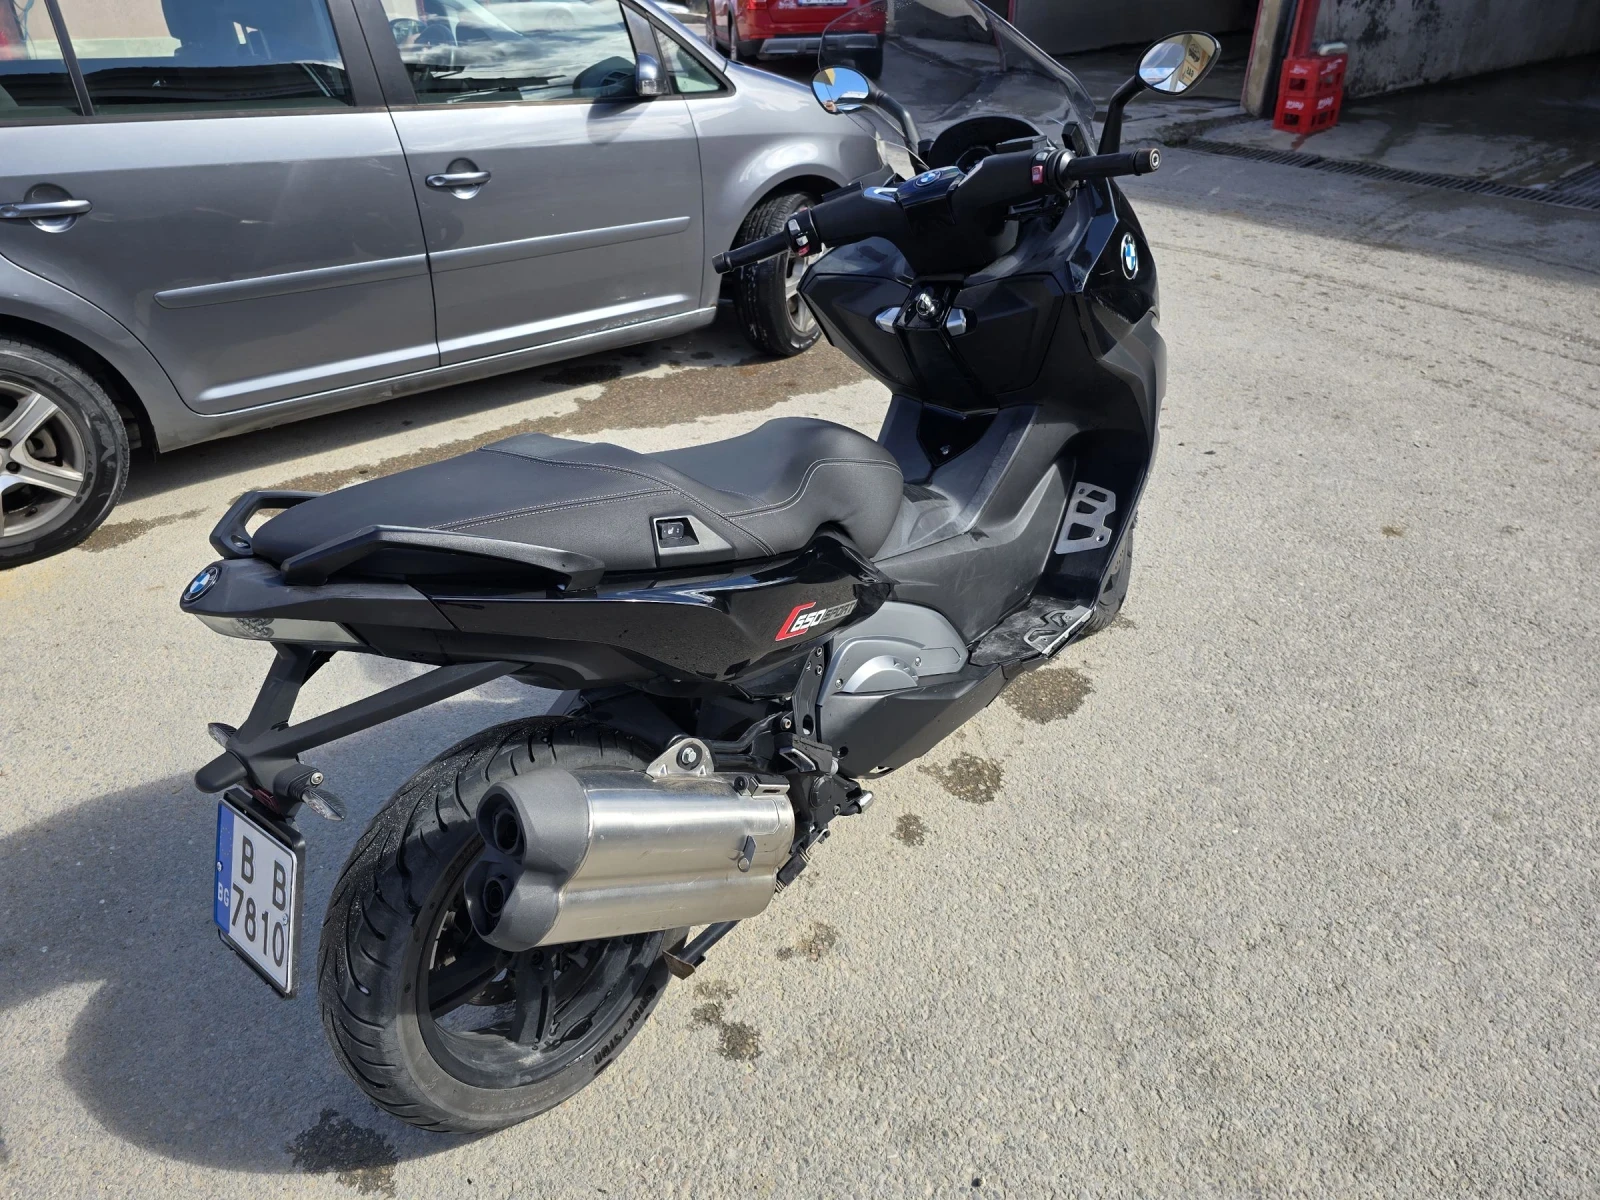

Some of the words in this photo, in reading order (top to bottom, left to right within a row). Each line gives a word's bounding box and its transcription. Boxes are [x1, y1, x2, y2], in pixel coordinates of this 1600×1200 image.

[821, 600, 858, 624] SPORT
[217, 881, 230, 907] BG
[241, 835, 254, 884] B
[272, 860, 287, 911] B
[232, 882, 285, 968] 7810
